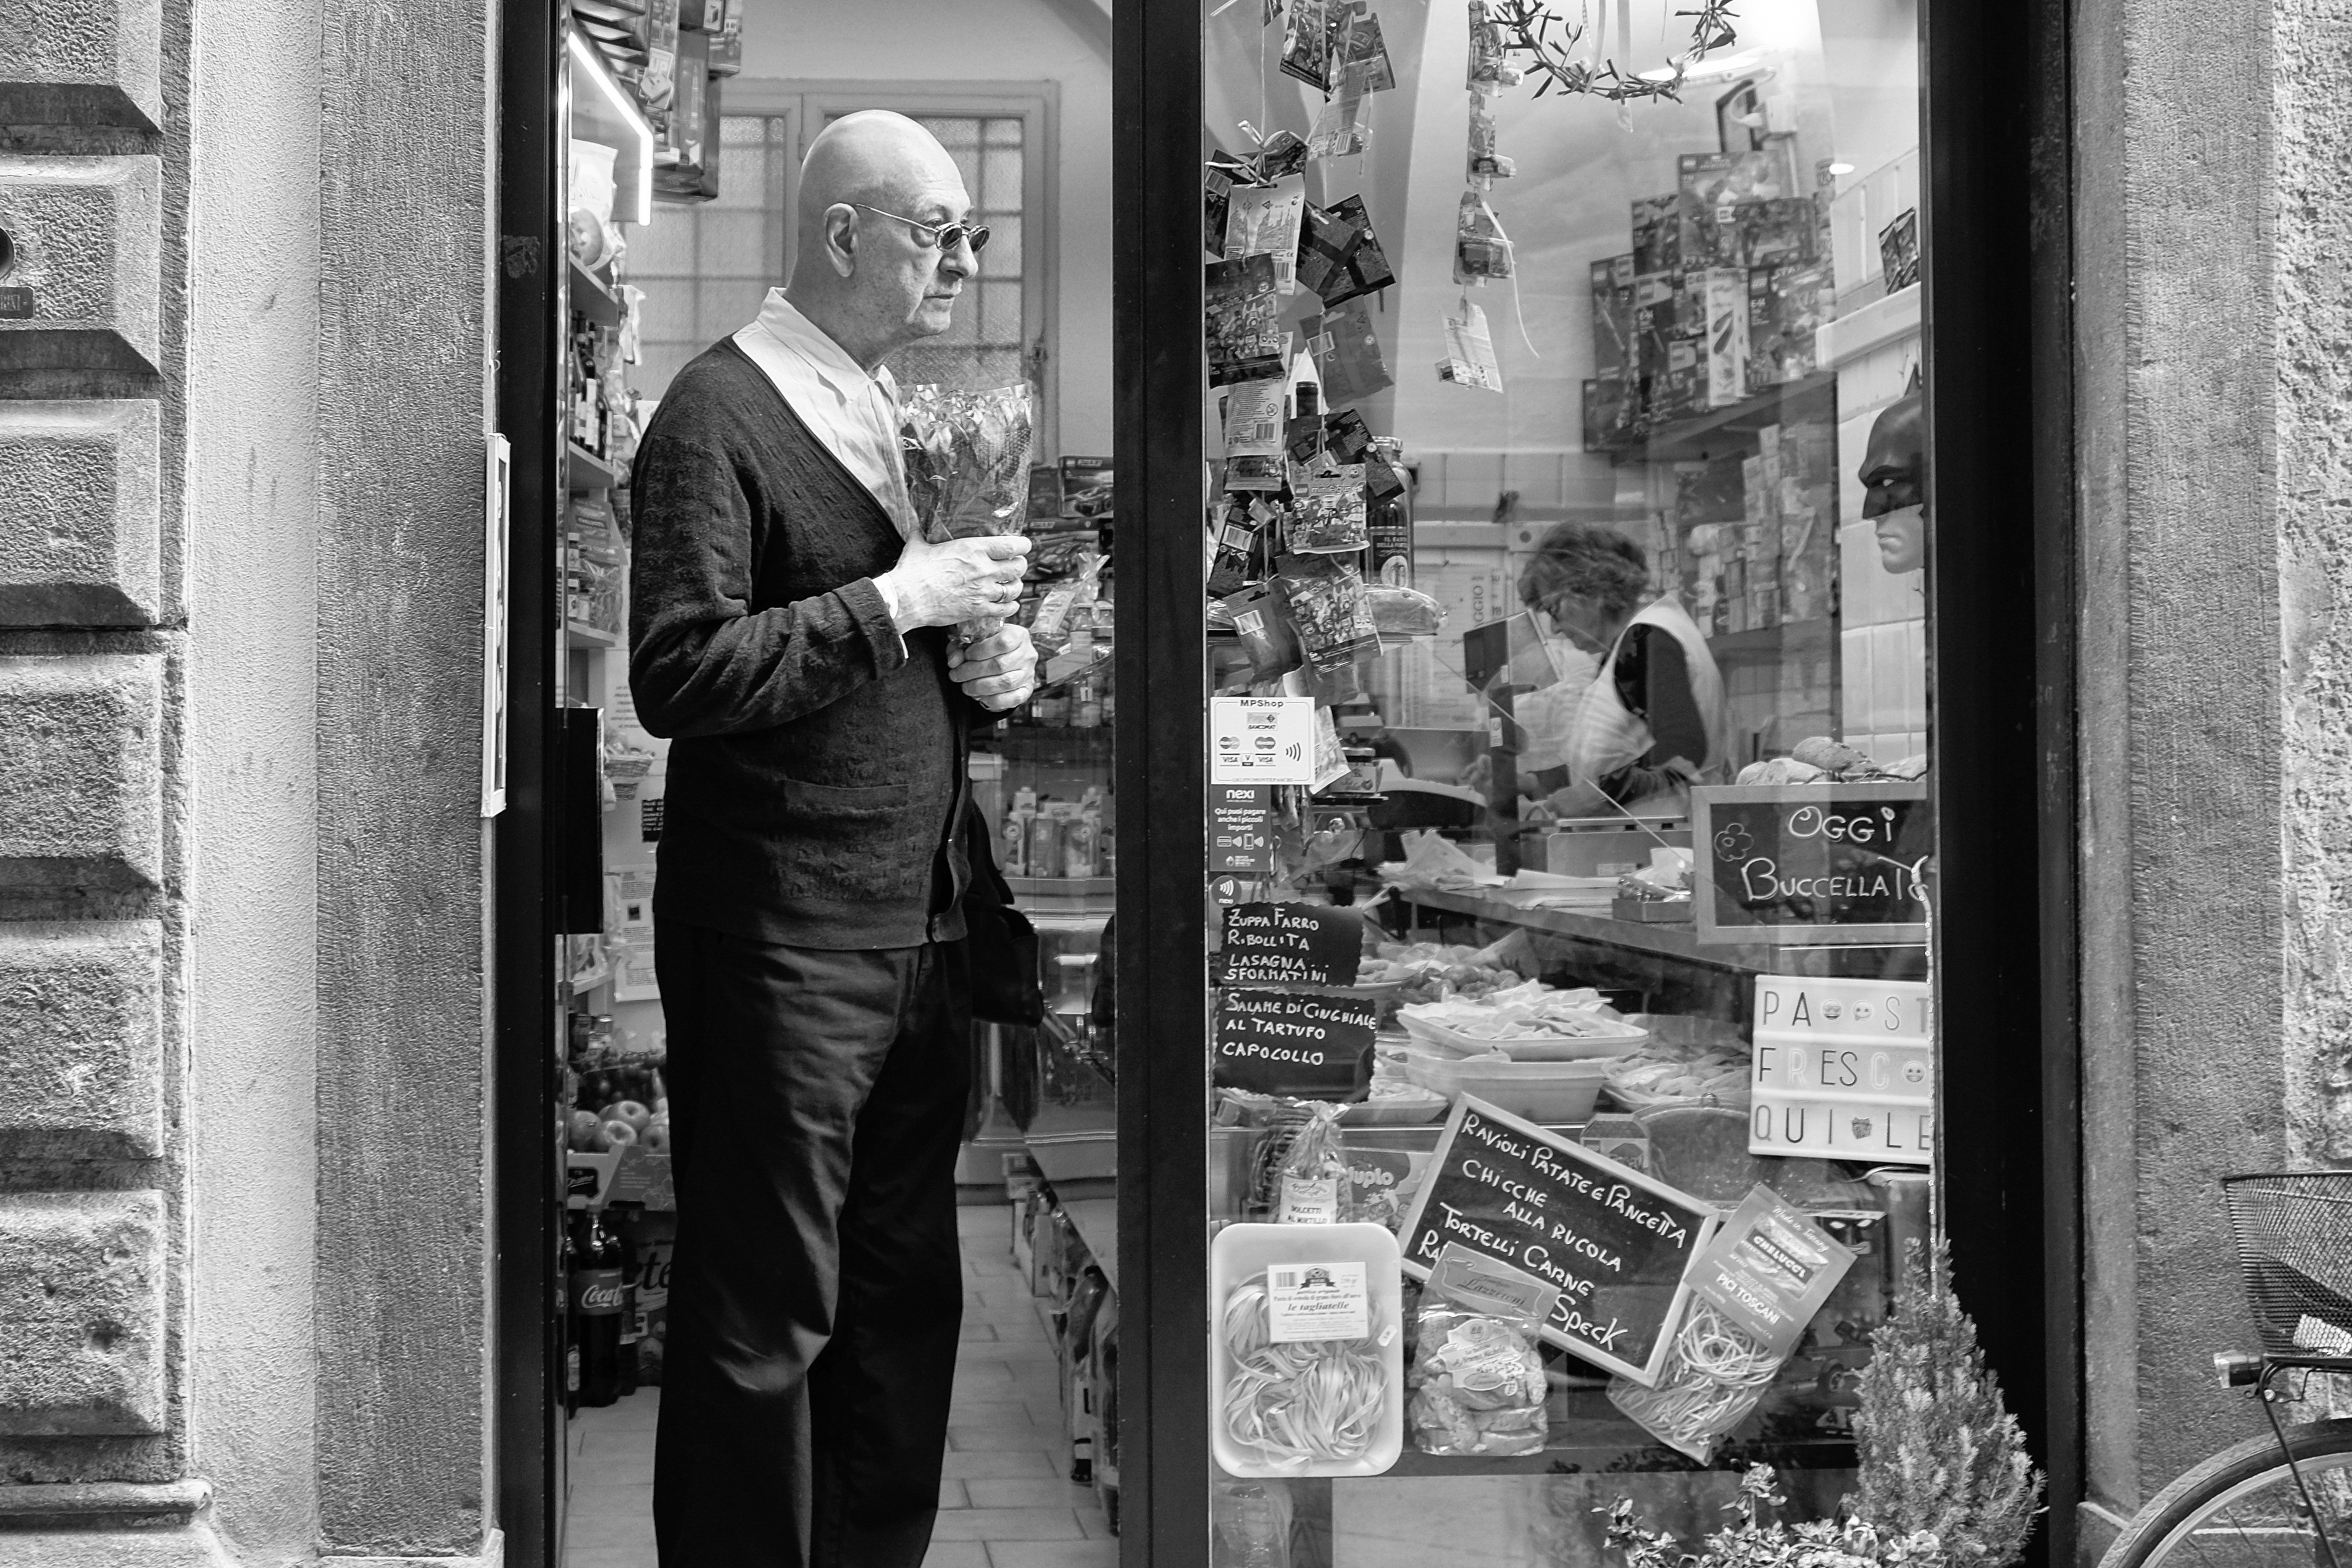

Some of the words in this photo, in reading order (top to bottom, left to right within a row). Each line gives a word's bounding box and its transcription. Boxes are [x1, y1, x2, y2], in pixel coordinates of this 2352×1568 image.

[1240, 699, 1283, 709] MPShop
[1226, 790, 1254, 799] nexi
[1228, 908, 1270, 927] ZUPPA
[1274, 907, 1319, 931] FARRO
[1224, 968, 1327, 983] SFORMATINI
[1225, 993, 1282, 1014] SALAME
[1303, 1003, 1377, 1030] CINGHIALE
[1225, 1019, 1246, 1031] AL
[1251, 1017, 1326, 1040] TARTUFO
[1222, 1041, 1324, 1066] CAPOCOLLO
[1462, 1159, 1549, 1208] CHICCHE
[1530, 1146, 1593, 1195] PATATE
[1604, 1183, 1688, 1249] PANCETTA
[1503, 1200, 1546, 1230] ALLA
[1551, 1223, 1623, 1273] RUCOLA
[1523, 1245, 1596, 1296] CARNE
[1753, 1235, 1806, 1278] CHELUCCI
[1287, 1303, 1298, 1311] le
[1299, 1301, 1350, 1312] tagliatelle
[1716, 1273, 1737, 1291] PICI
[1737, 1288, 1781, 1325] TOSCANI
